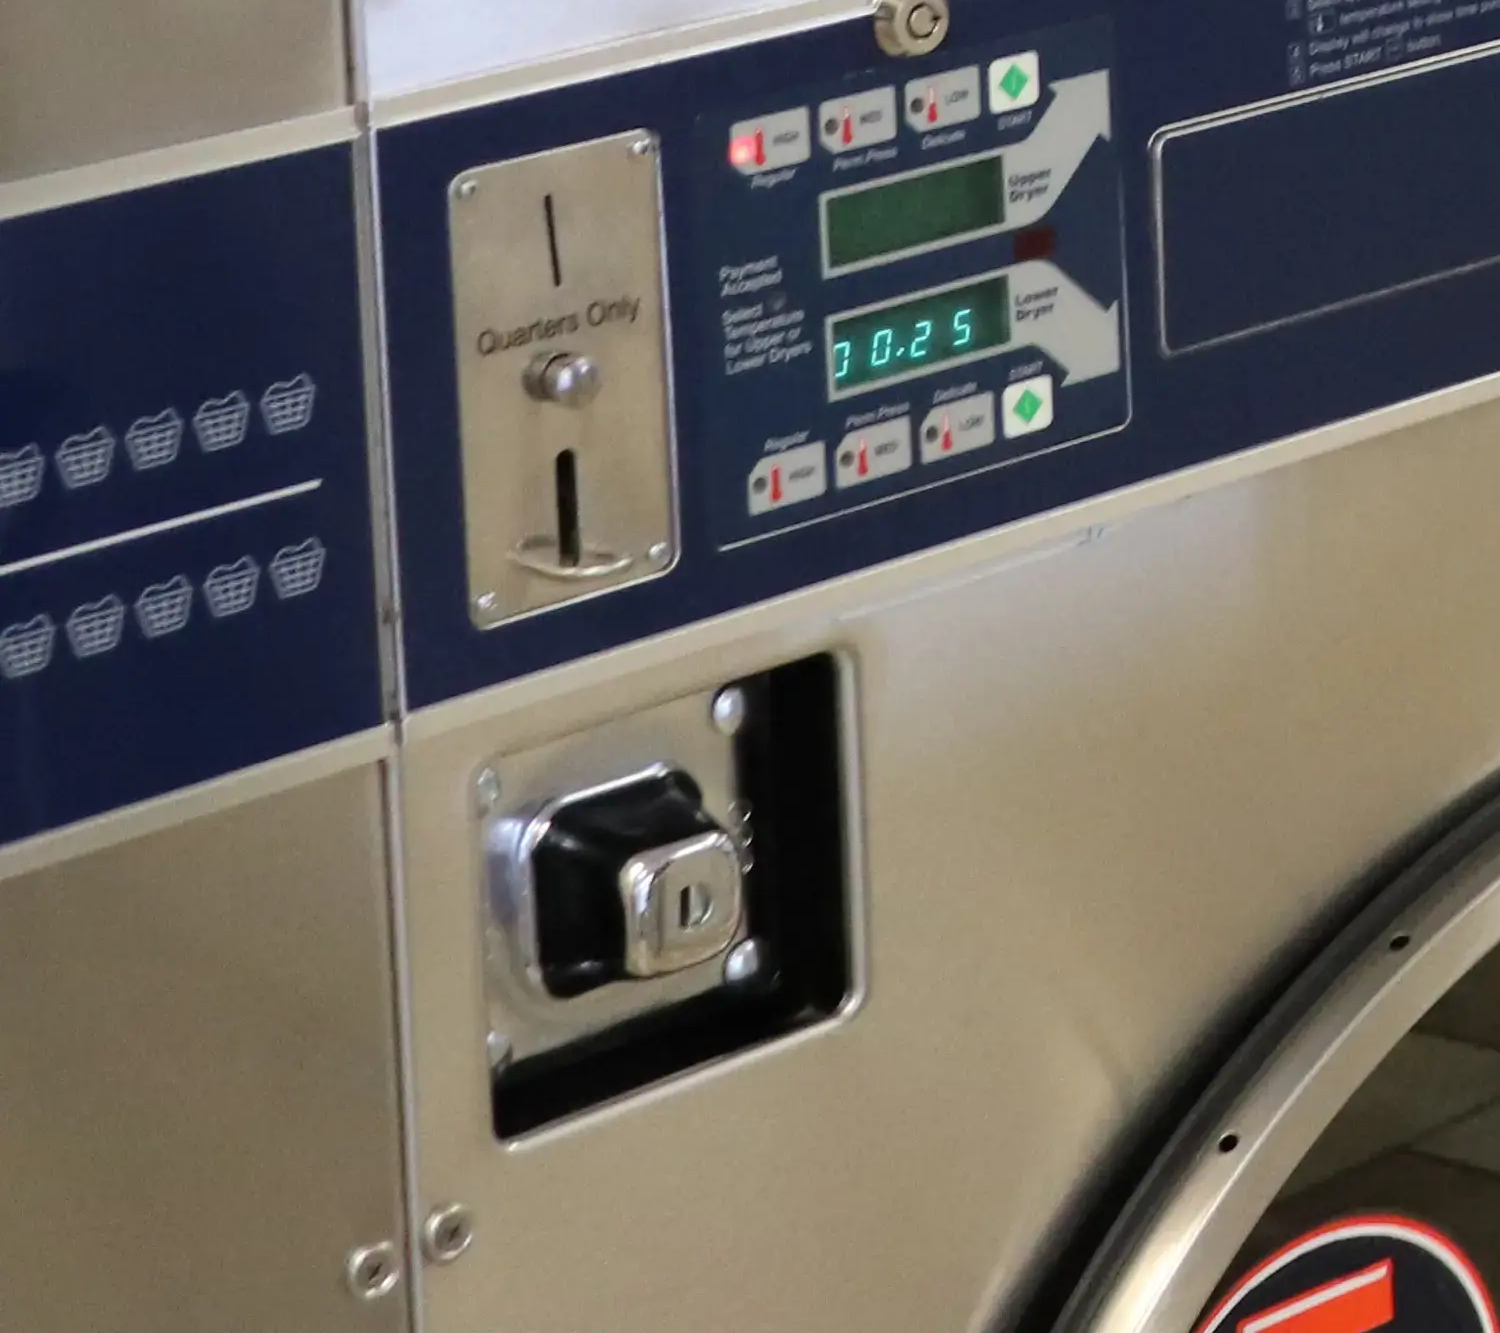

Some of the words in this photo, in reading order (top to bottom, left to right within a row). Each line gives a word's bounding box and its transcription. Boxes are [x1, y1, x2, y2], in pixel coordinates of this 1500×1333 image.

[1008, 168, 1052, 186] Upper
[1009, 184, 1048, 203] Dryer
[1014, 287, 1058, 306] Lower
[1015, 304, 1054, 322] Dryer
[477, 312, 580, 357] Quarters
[586, 294, 641, 328] Only
